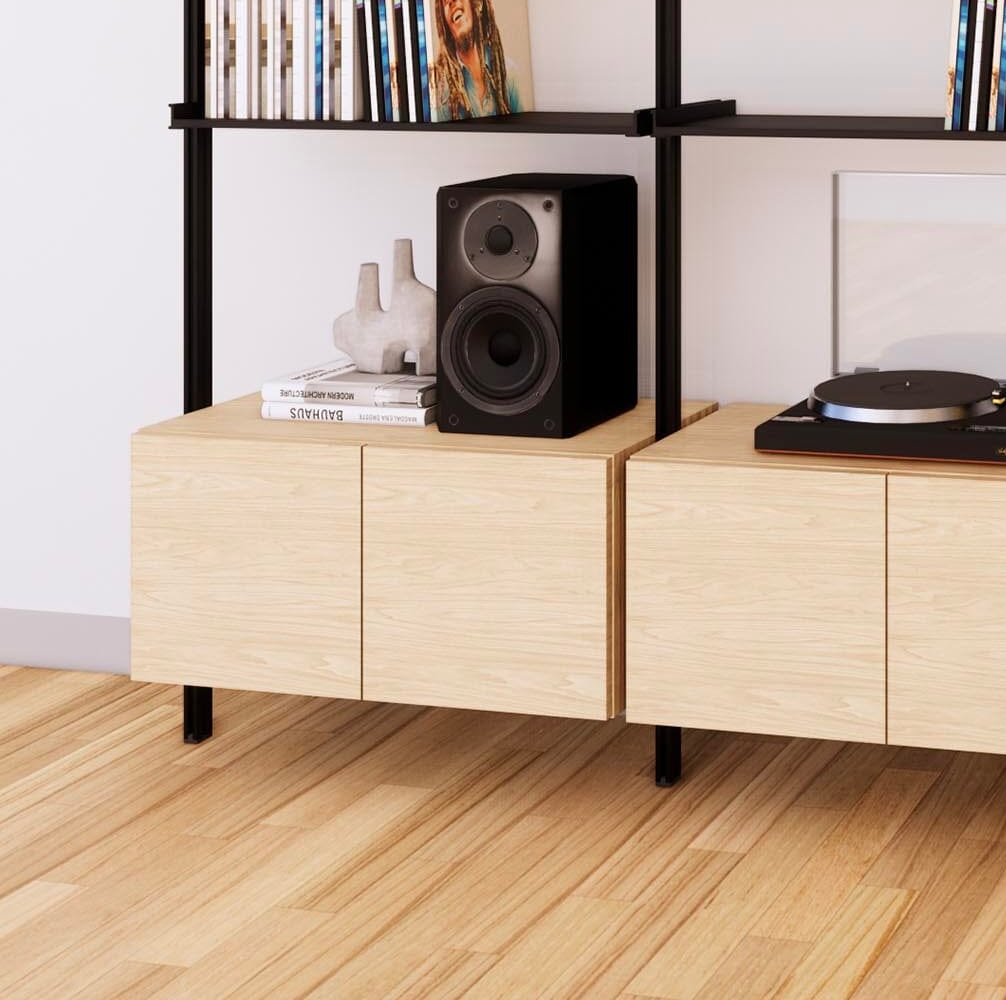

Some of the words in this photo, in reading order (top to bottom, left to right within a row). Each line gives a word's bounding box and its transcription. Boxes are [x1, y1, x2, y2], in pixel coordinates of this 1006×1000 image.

[280, 390, 326, 399] ARCHITECTURE
[328, 392, 354, 400] MODERN
[289, 408, 344, 421] BAUHAUS
